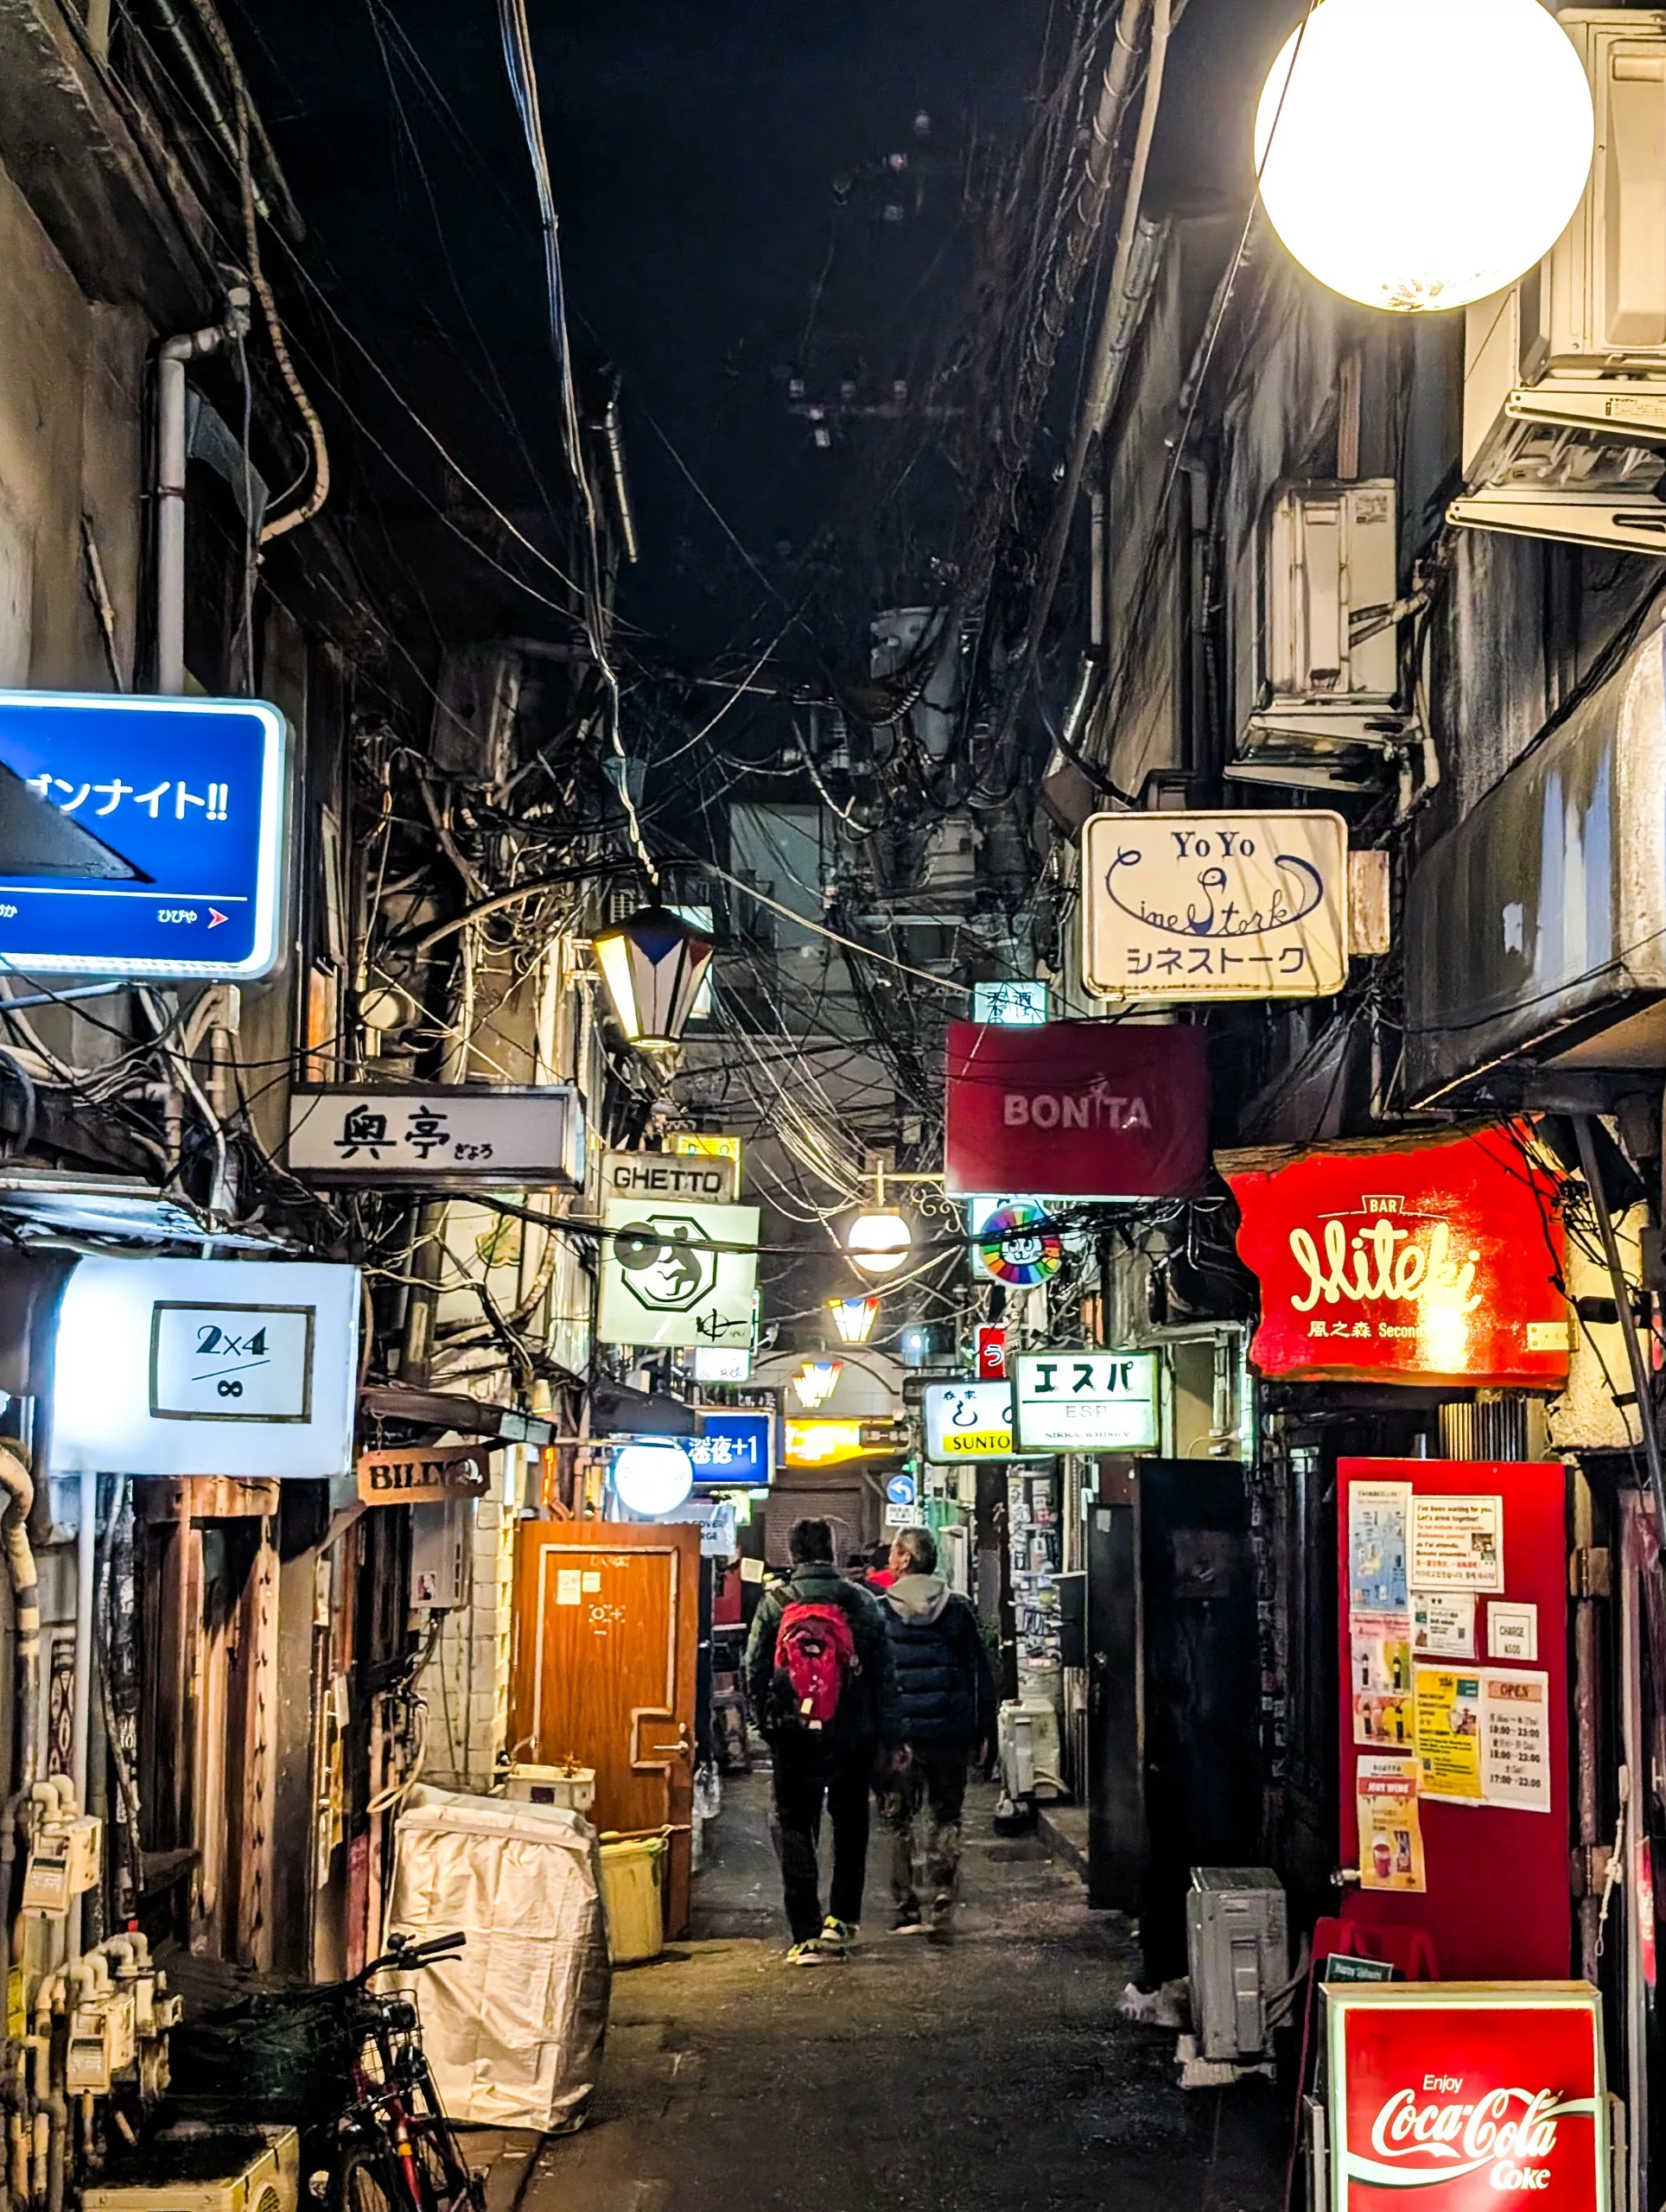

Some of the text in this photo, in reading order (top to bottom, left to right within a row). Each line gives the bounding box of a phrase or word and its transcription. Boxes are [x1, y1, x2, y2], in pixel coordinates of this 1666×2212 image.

[157, 909, 197, 924] ひびや
[1127, 947, 1304, 975] シネストーク
[1003, 1074, 1152, 1129] BONITA
[614, 1166, 722, 1194] GHETTO
[1370, 1199, 1397, 1213] BAR
[1307, 1321, 1371, 1338] 風之森
[1034, 1360, 1135, 1394] エスパ
[1066, 1405, 1107, 1418] ESP
[688, 1435, 757, 1464] 深夜+1
[1499, 1625, 1525, 1637] CHARGE
[1500, 1683, 1529, 1698] OPEN
[1422, 2074, 1463, 2093] Enjoy
[1371, 2088, 1562, 2158] Coca-Cola
[1490, 2160, 1551, 2190] Coke
